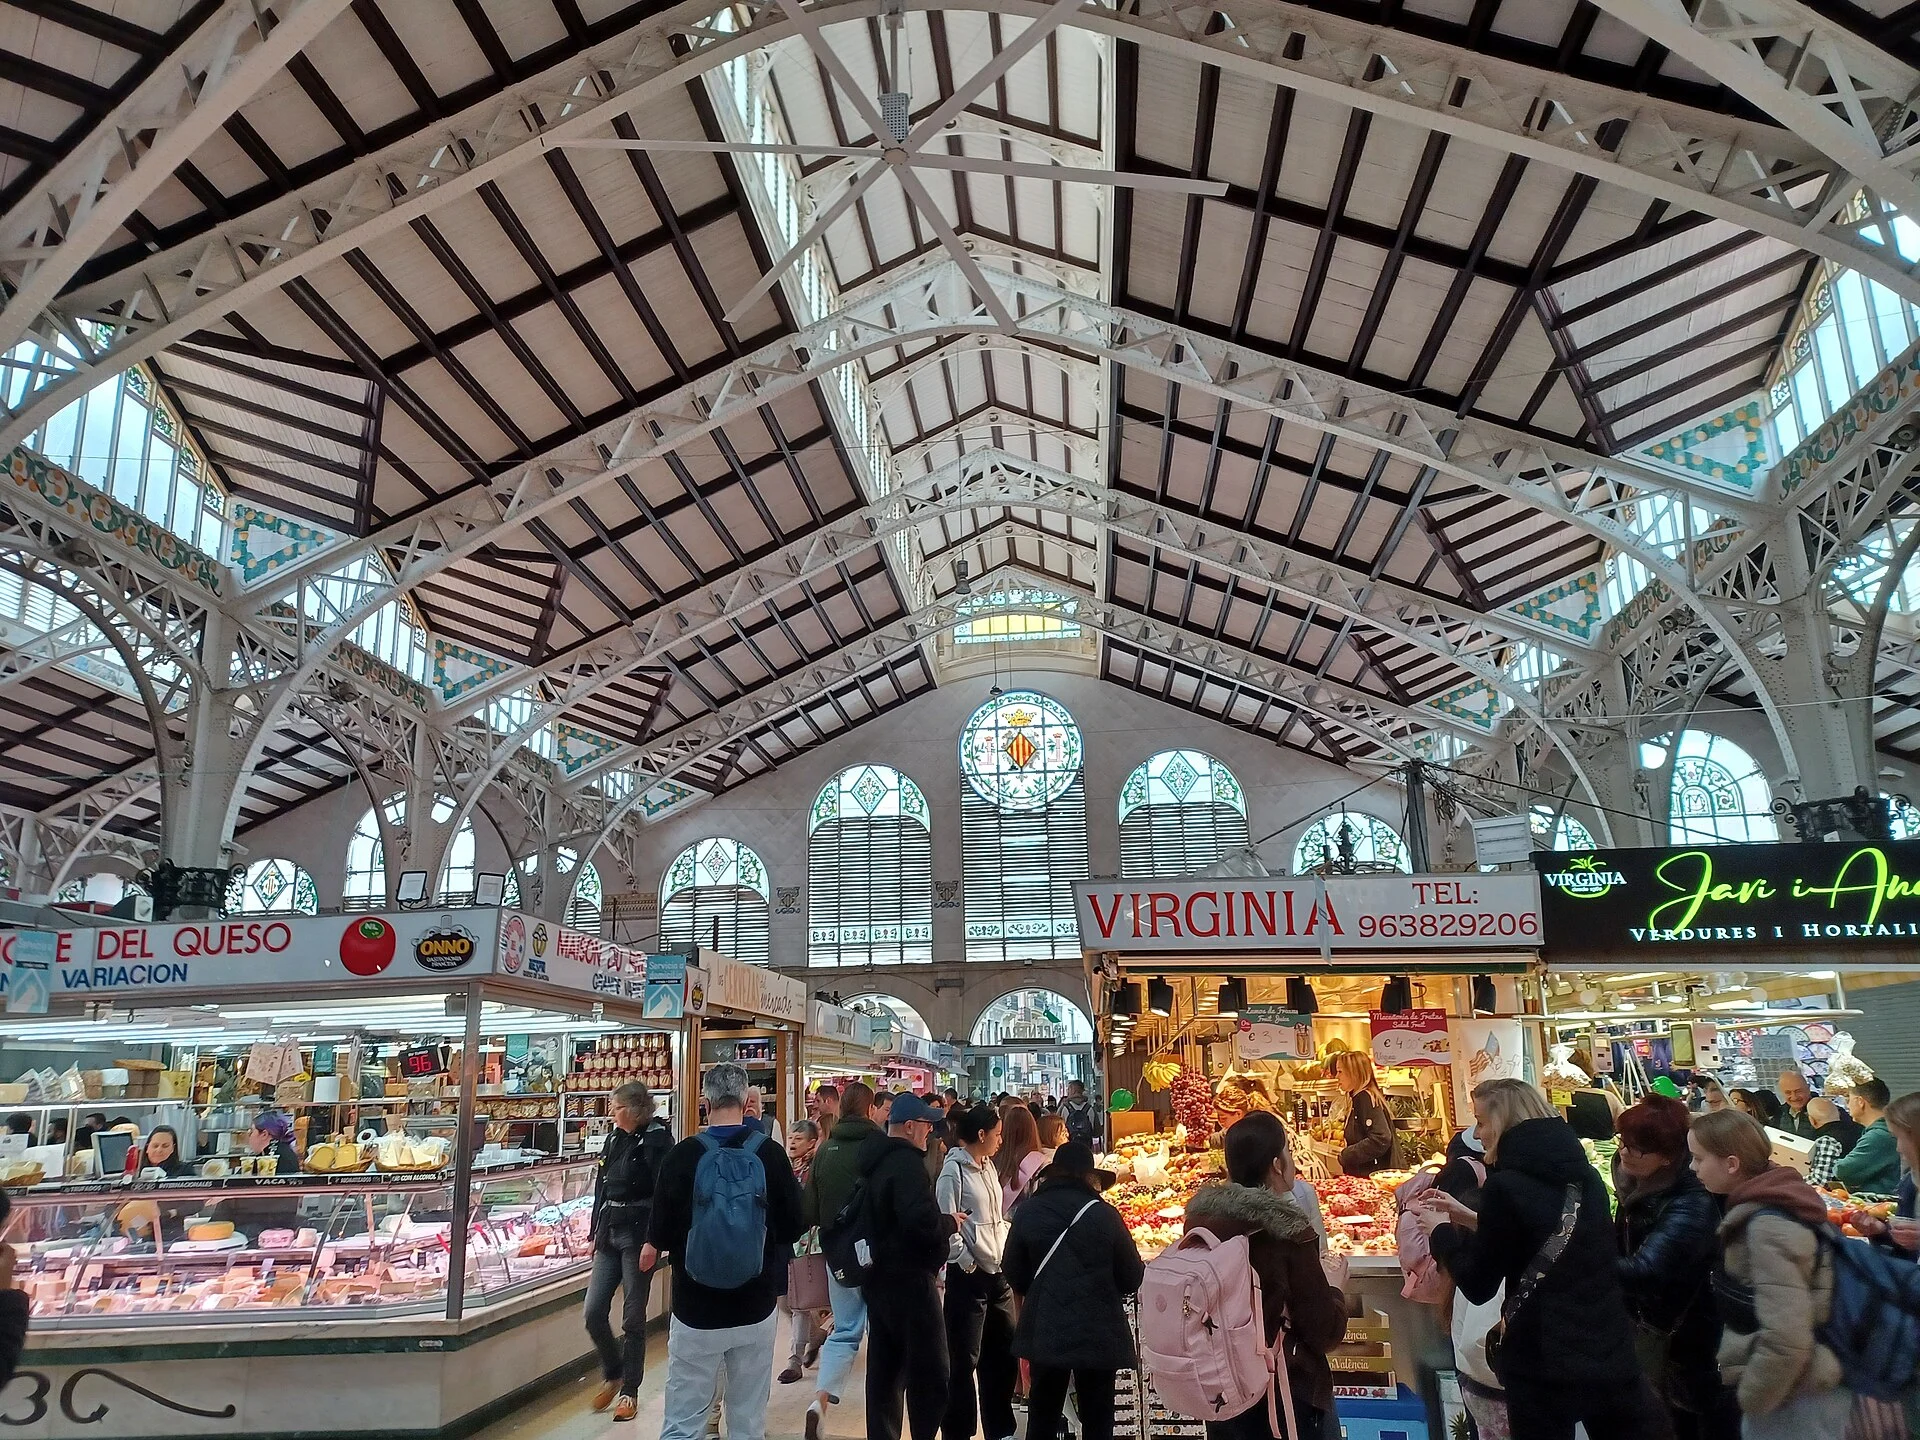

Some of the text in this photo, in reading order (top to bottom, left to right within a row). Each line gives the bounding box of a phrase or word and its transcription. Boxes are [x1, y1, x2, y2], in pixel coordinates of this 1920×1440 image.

[1544, 871, 1628, 887] VIRGINIA
[1411, 882, 1479, 905] TEL:
[1648, 851, 1777, 938] Javi
[1087, 890, 1344, 939] VIRGINIA
[1358, 912, 1538, 938] 963829206
[97, 929, 153, 960] DEL
[173, 922, 292, 958] QUESO
[1629, 926, 1758, 942] VERDURES
[420, 938, 470, 956] ONNO
[62, 963, 188, 988] VARIACION
[649, 962, 677, 970] Servicio
[409, 1054, 432, 1073] 96
[1343, 1330, 1368, 1340] lència
